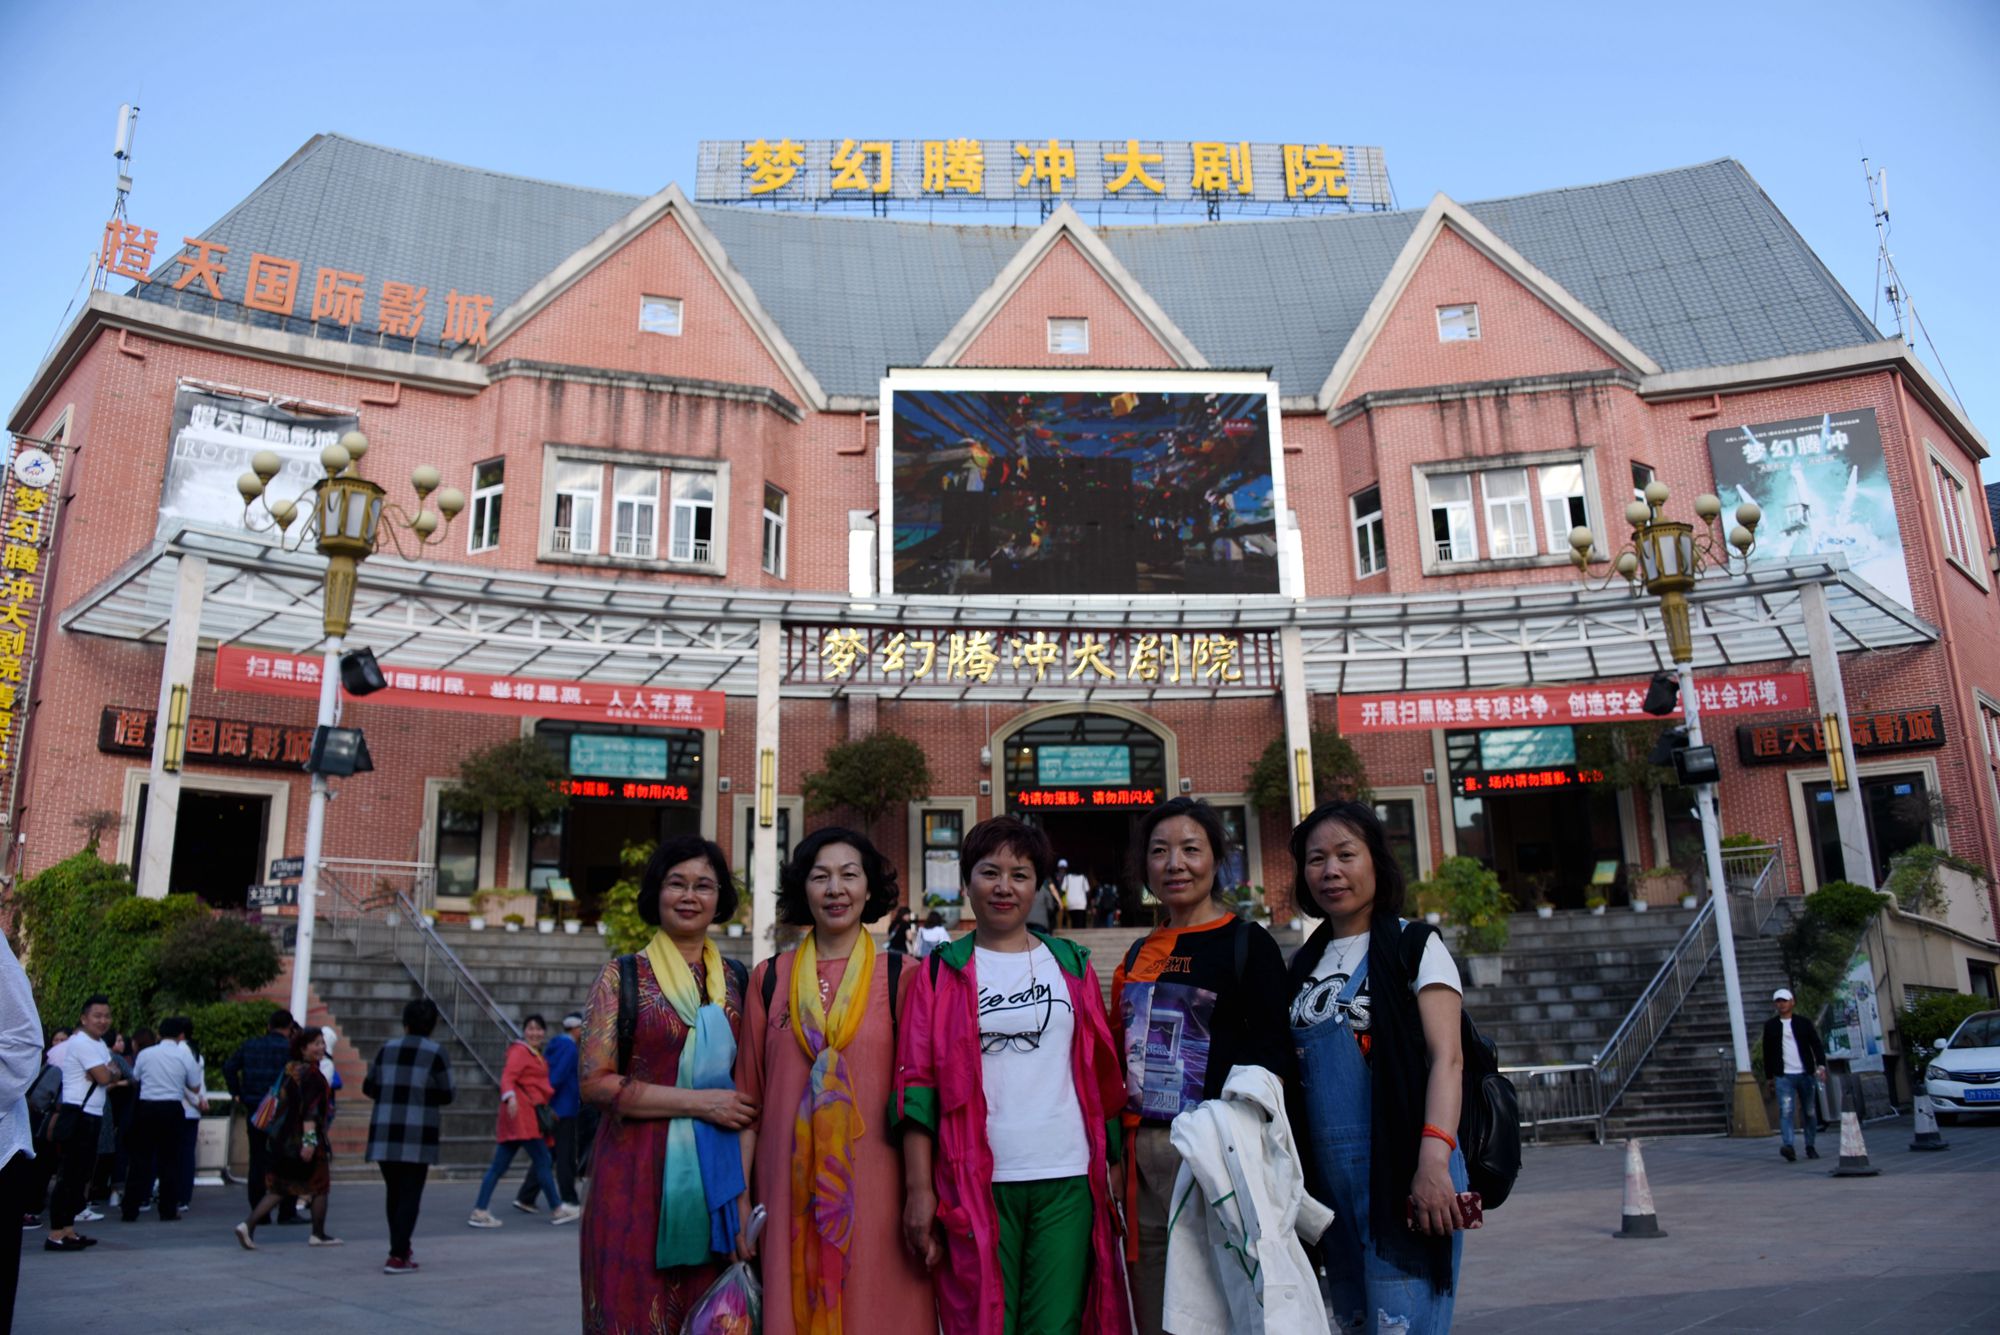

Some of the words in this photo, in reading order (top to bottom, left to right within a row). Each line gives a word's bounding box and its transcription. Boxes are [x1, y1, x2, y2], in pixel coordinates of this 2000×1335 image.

[743, 138, 1350, 198] 梦幻腾冲大剧院
[100, 218, 494, 346] 橙天国际影城
[820, 628, 1243, 683] 梦幻腾冲大剧院
[114, 711, 312, 761] 橙国际影城
